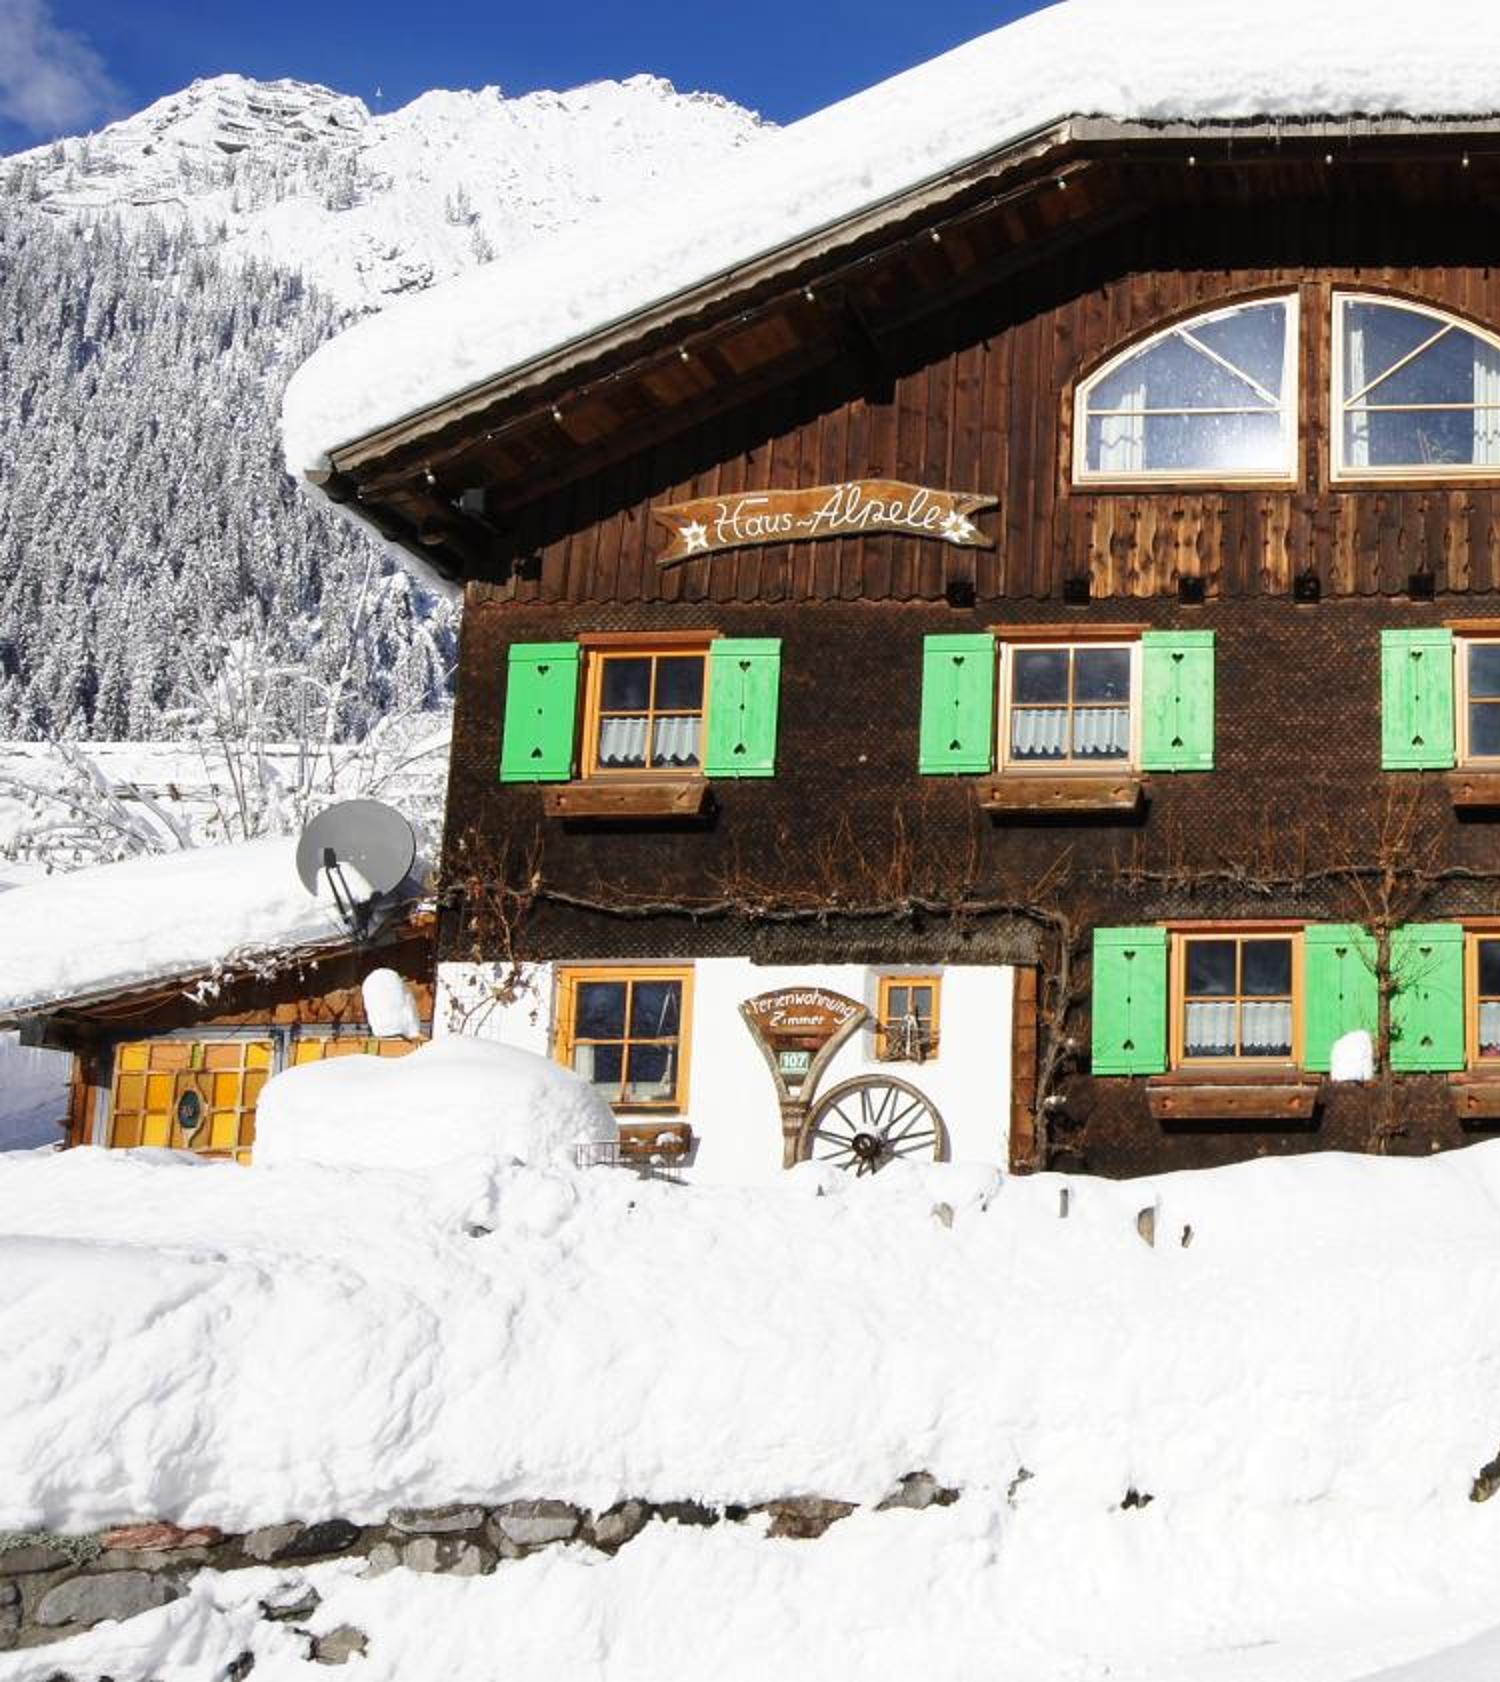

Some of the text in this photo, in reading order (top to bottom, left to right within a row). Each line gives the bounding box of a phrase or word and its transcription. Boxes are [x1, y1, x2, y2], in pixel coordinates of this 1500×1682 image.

[714, 497, 792, 543] Haus
[769, 1009, 825, 1027] Zimmer
[783, 1052, 806, 1068] 107
